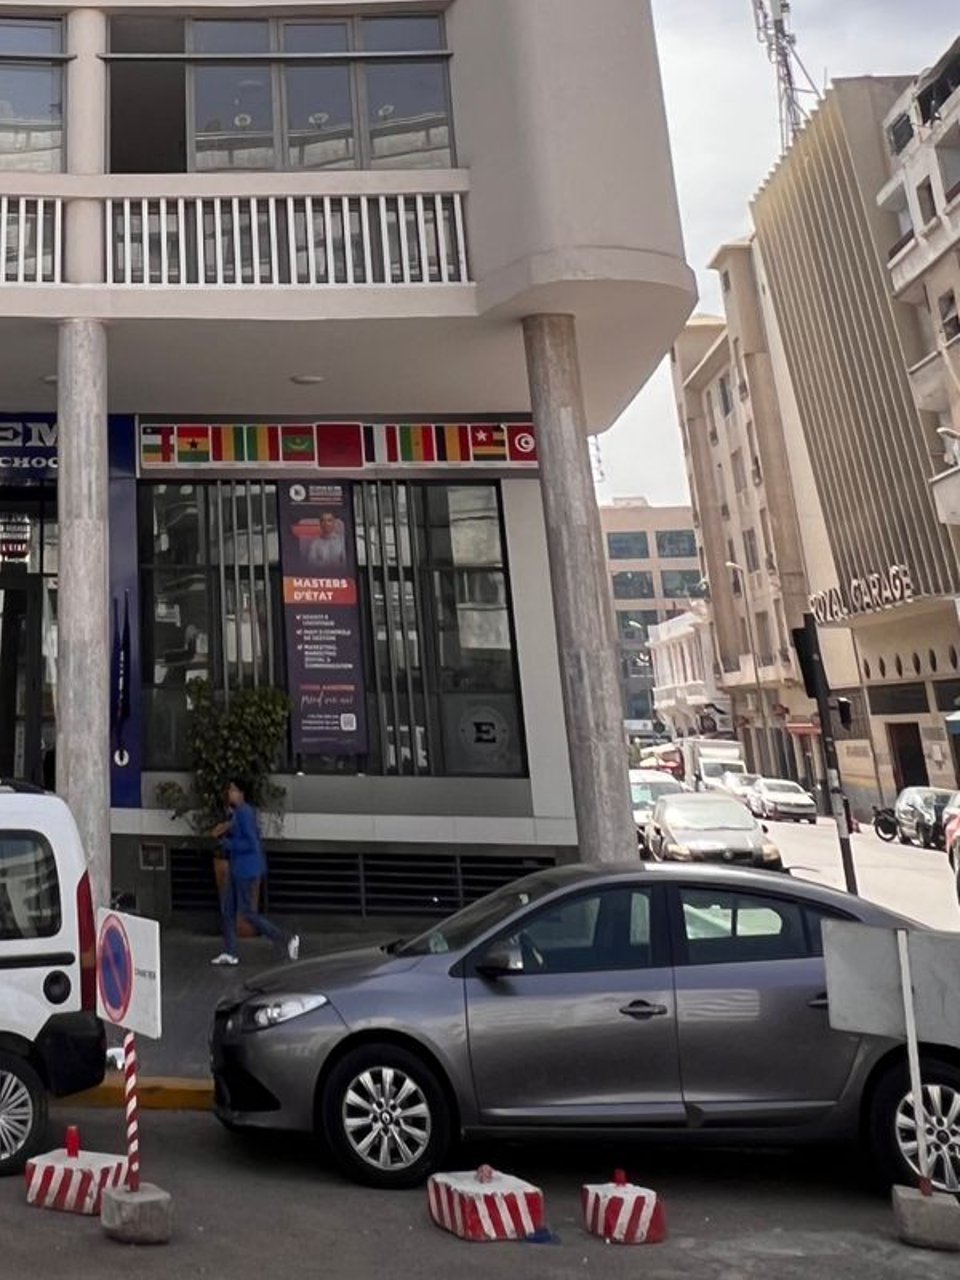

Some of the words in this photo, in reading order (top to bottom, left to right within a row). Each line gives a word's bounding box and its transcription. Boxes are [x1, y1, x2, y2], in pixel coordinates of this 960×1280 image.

[293, 578, 348, 588] MASTERS
[851, 565, 913, 614] GARAGE
[473, 722, 496, 743] E
